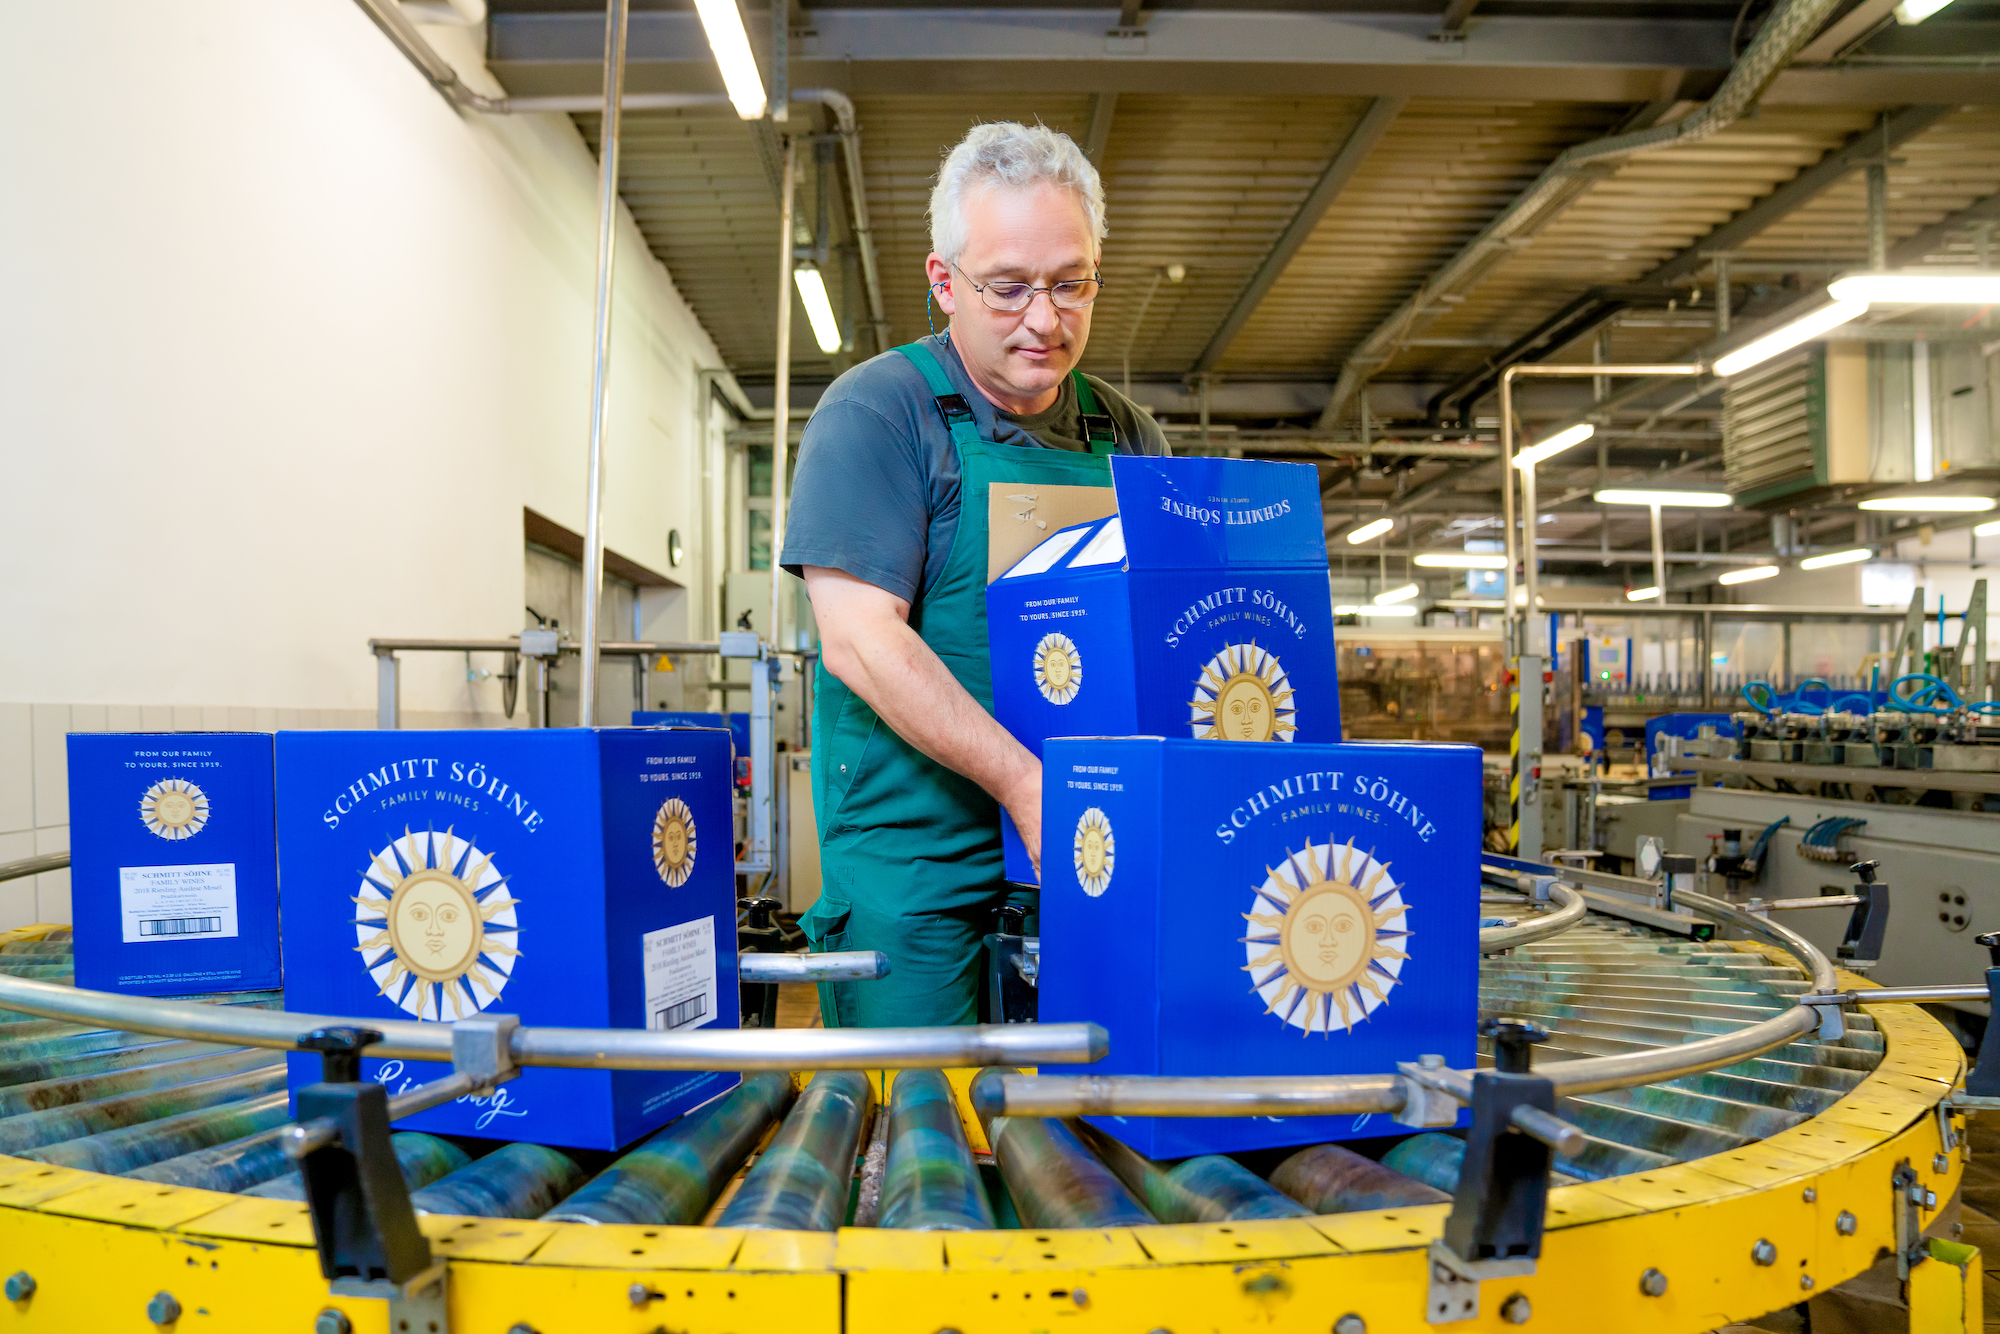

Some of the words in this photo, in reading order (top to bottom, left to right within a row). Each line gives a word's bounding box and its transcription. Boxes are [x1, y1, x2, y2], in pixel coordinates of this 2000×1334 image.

[1208, 495, 1228, 503] WINES
[1160, 496, 1221, 526] SÖHNE
[1226, 499, 1291, 525] SCHMITT
[1024, 600, 1042, 608] FROM
[1043, 598, 1057, 606] OUR
[1057, 596, 1079, 605] FAMILY
[1019, 614, 1028, 622] TO
[1052, 610, 1069, 619] SINCE
[1070, 609, 1088, 617] 1919.
[1164, 587, 1246, 649] SCHMITT
[1252, 589, 1307, 640] SÖHNE
[1208, 611, 1241, 629] FAMILY
[1244, 612, 1271, 627] WINES
[646, 756, 663, 765] FROM
[664, 756, 676, 765] OUR
[677, 755, 696, 764] FAMILY
[640, 773, 648, 782] TO
[671, 771, 688, 780] SINCE
[688, 771, 703, 780] 1919.
[1072, 765, 1087, 773] FROM
[1087, 765, 1099, 774] OUR
[1099, 766, 1119, 775] FAMILY
[1067, 780, 1074, 789] TO
[1093, 782, 1109, 791] SINCE
[323, 758, 439, 830] SCHMITT
[450, 762, 544, 833] SÖHNE
[380, 789, 429, 810] FAMILY
[435, 790, 480, 812] WINES
[1215, 771, 1344, 845] SCHMITT
[1353, 776, 1437, 843] SÖHNE
[1280, 802, 1331, 823] FAMILY
[1337, 803, 1380, 824] WINES
[142, 871, 181, 879] SCHMITT
